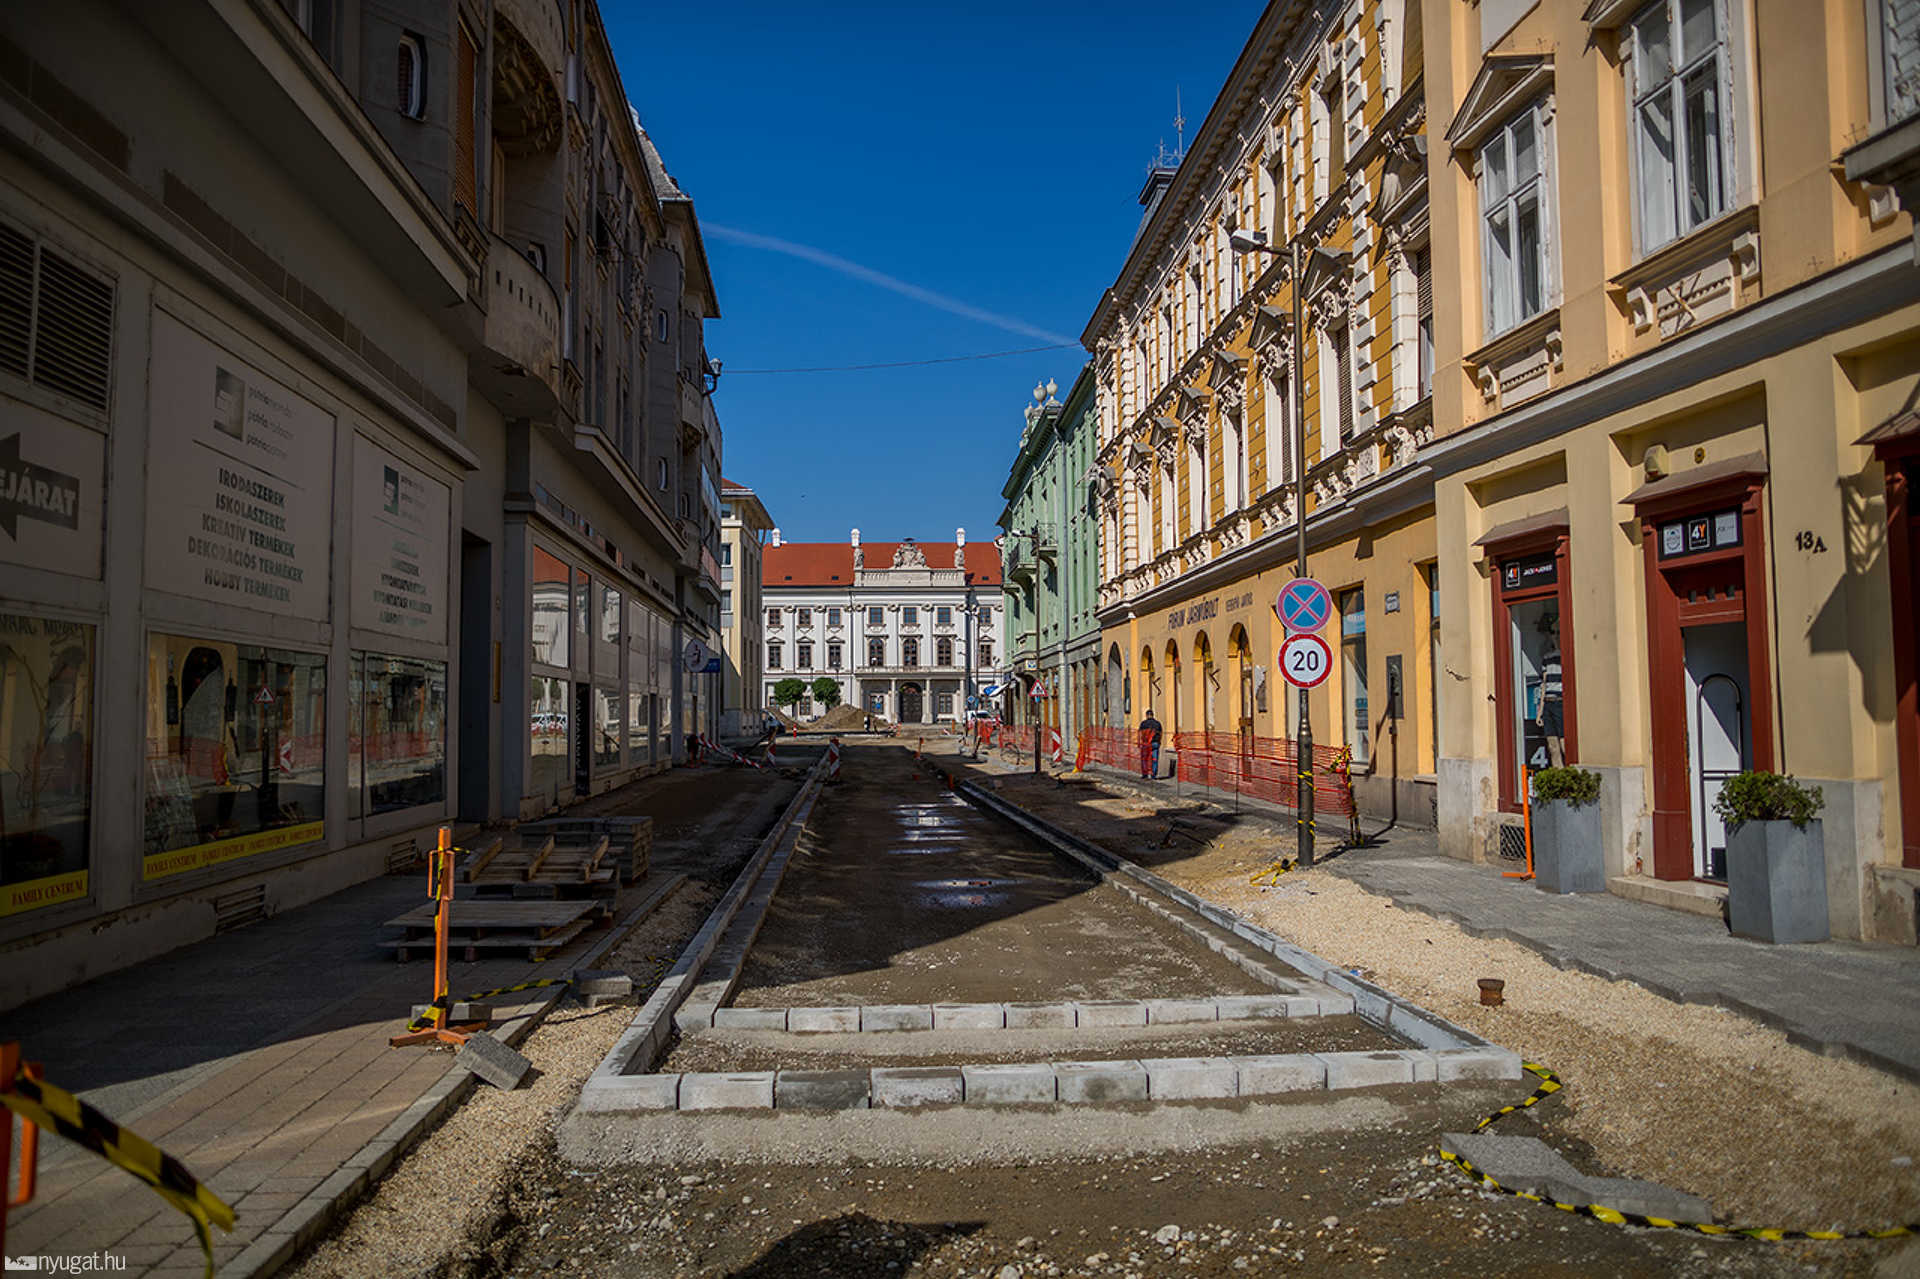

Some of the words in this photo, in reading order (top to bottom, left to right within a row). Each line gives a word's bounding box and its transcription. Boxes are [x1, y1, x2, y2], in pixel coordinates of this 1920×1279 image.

[218, 468, 285, 509] IRODASZEREK
[215, 493, 286, 532] ISKOLASZEREK
[202, 513, 246, 542] KREATÍV
[248, 528, 295, 559] TERMÉKEK
[1691, 523, 1706, 539] 4Y
[259, 554, 303, 583] TERMÉKEK
[1293, 650, 1319, 671] 20
[11, 886, 44, 906] FAMILY
[44, 879, 84, 900] CENTRUM
